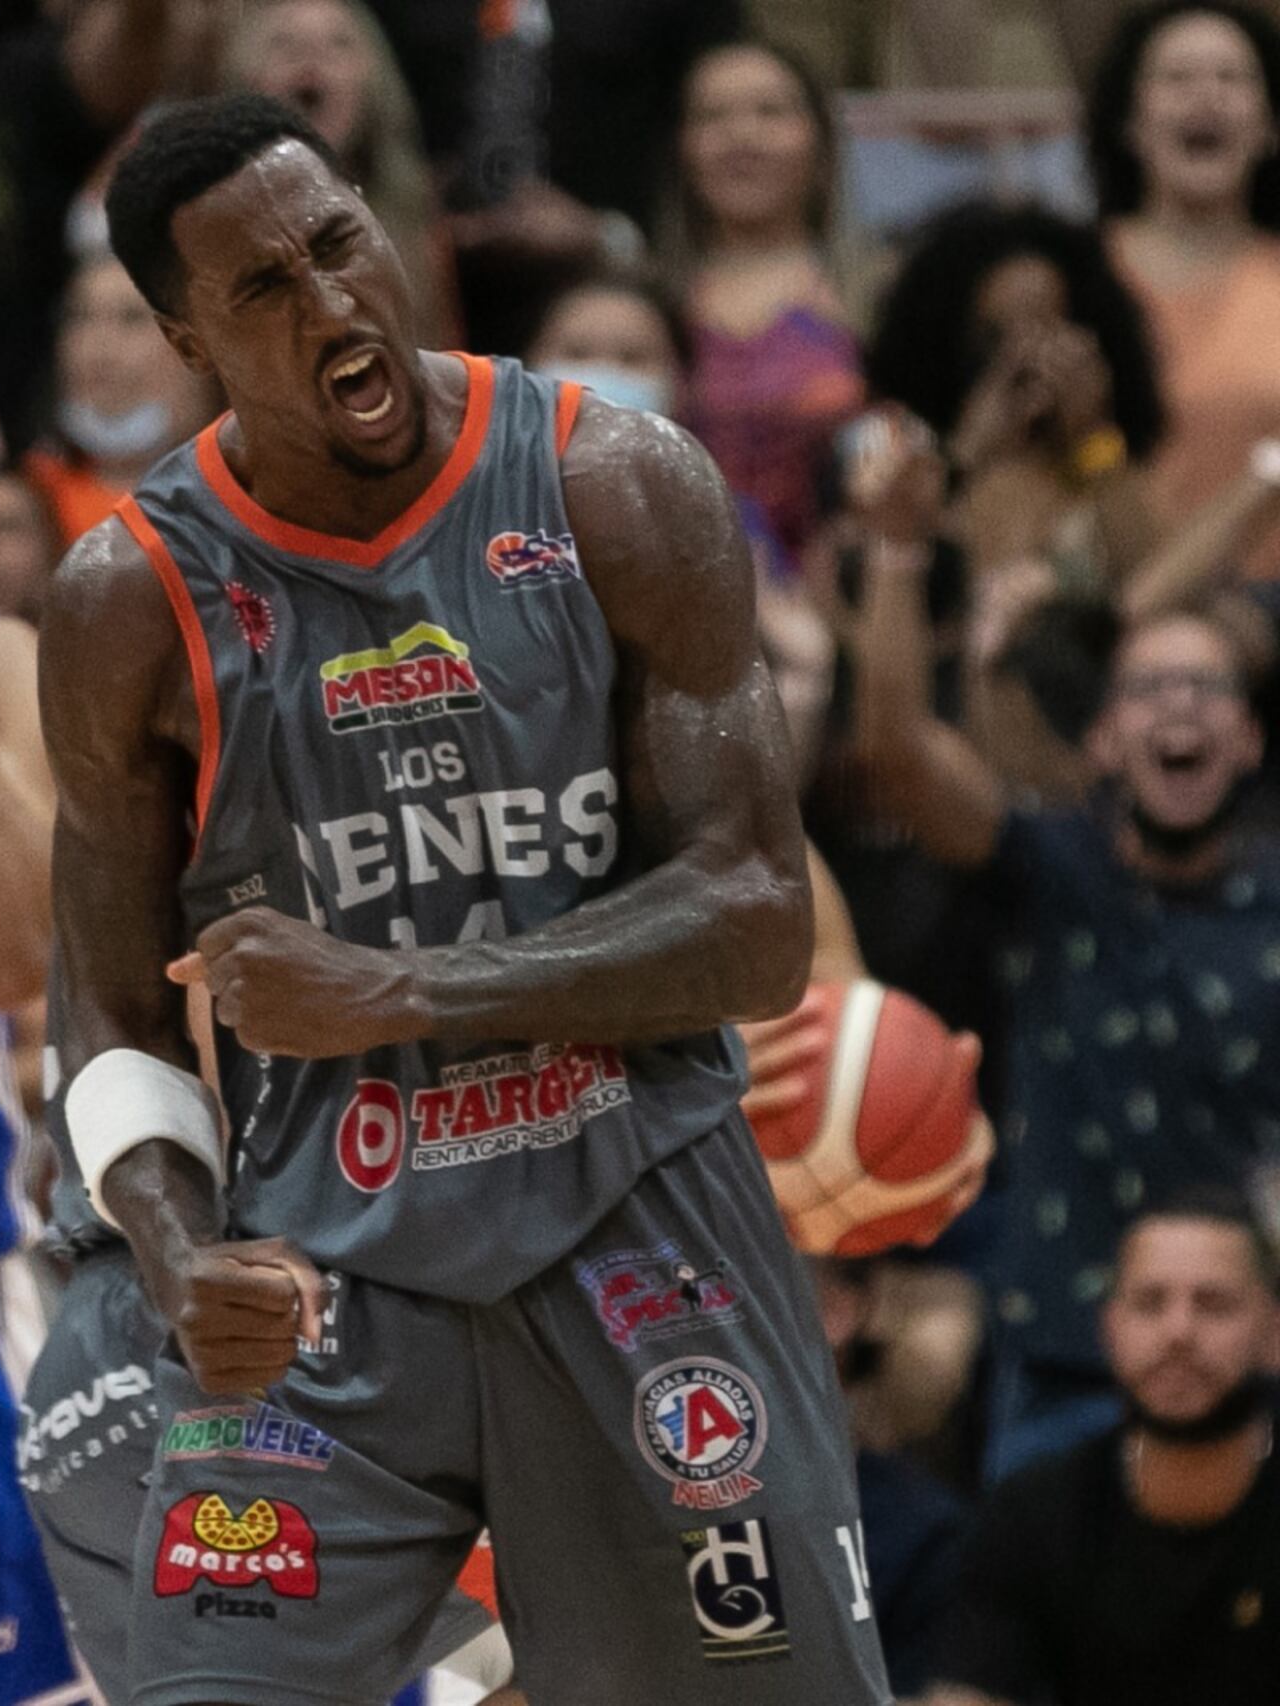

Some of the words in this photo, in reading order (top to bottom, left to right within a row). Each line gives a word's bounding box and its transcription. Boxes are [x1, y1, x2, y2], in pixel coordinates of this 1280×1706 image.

[323, 655, 481, 719] MESON
[377, 741, 466, 793] LOS
[226, 873, 268, 906] 1932
[411, 1043, 627, 1145] TARGET
[413, 1145, 464, 1170] RENT
[463, 1141, 478, 1163] A
[479, 1130, 520, 1160] CAR
[530, 1116, 578, 1149] RENT
[691, 1369, 754, 1422] ALIADAS
[688, 1465, 710, 1479] TU
[711, 1437, 750, 1476] SALUD
[672, 1469, 764, 1510] NELIA
[169, 1542, 306, 1573] marco's
[194, 1594, 278, 1619] Pizza
